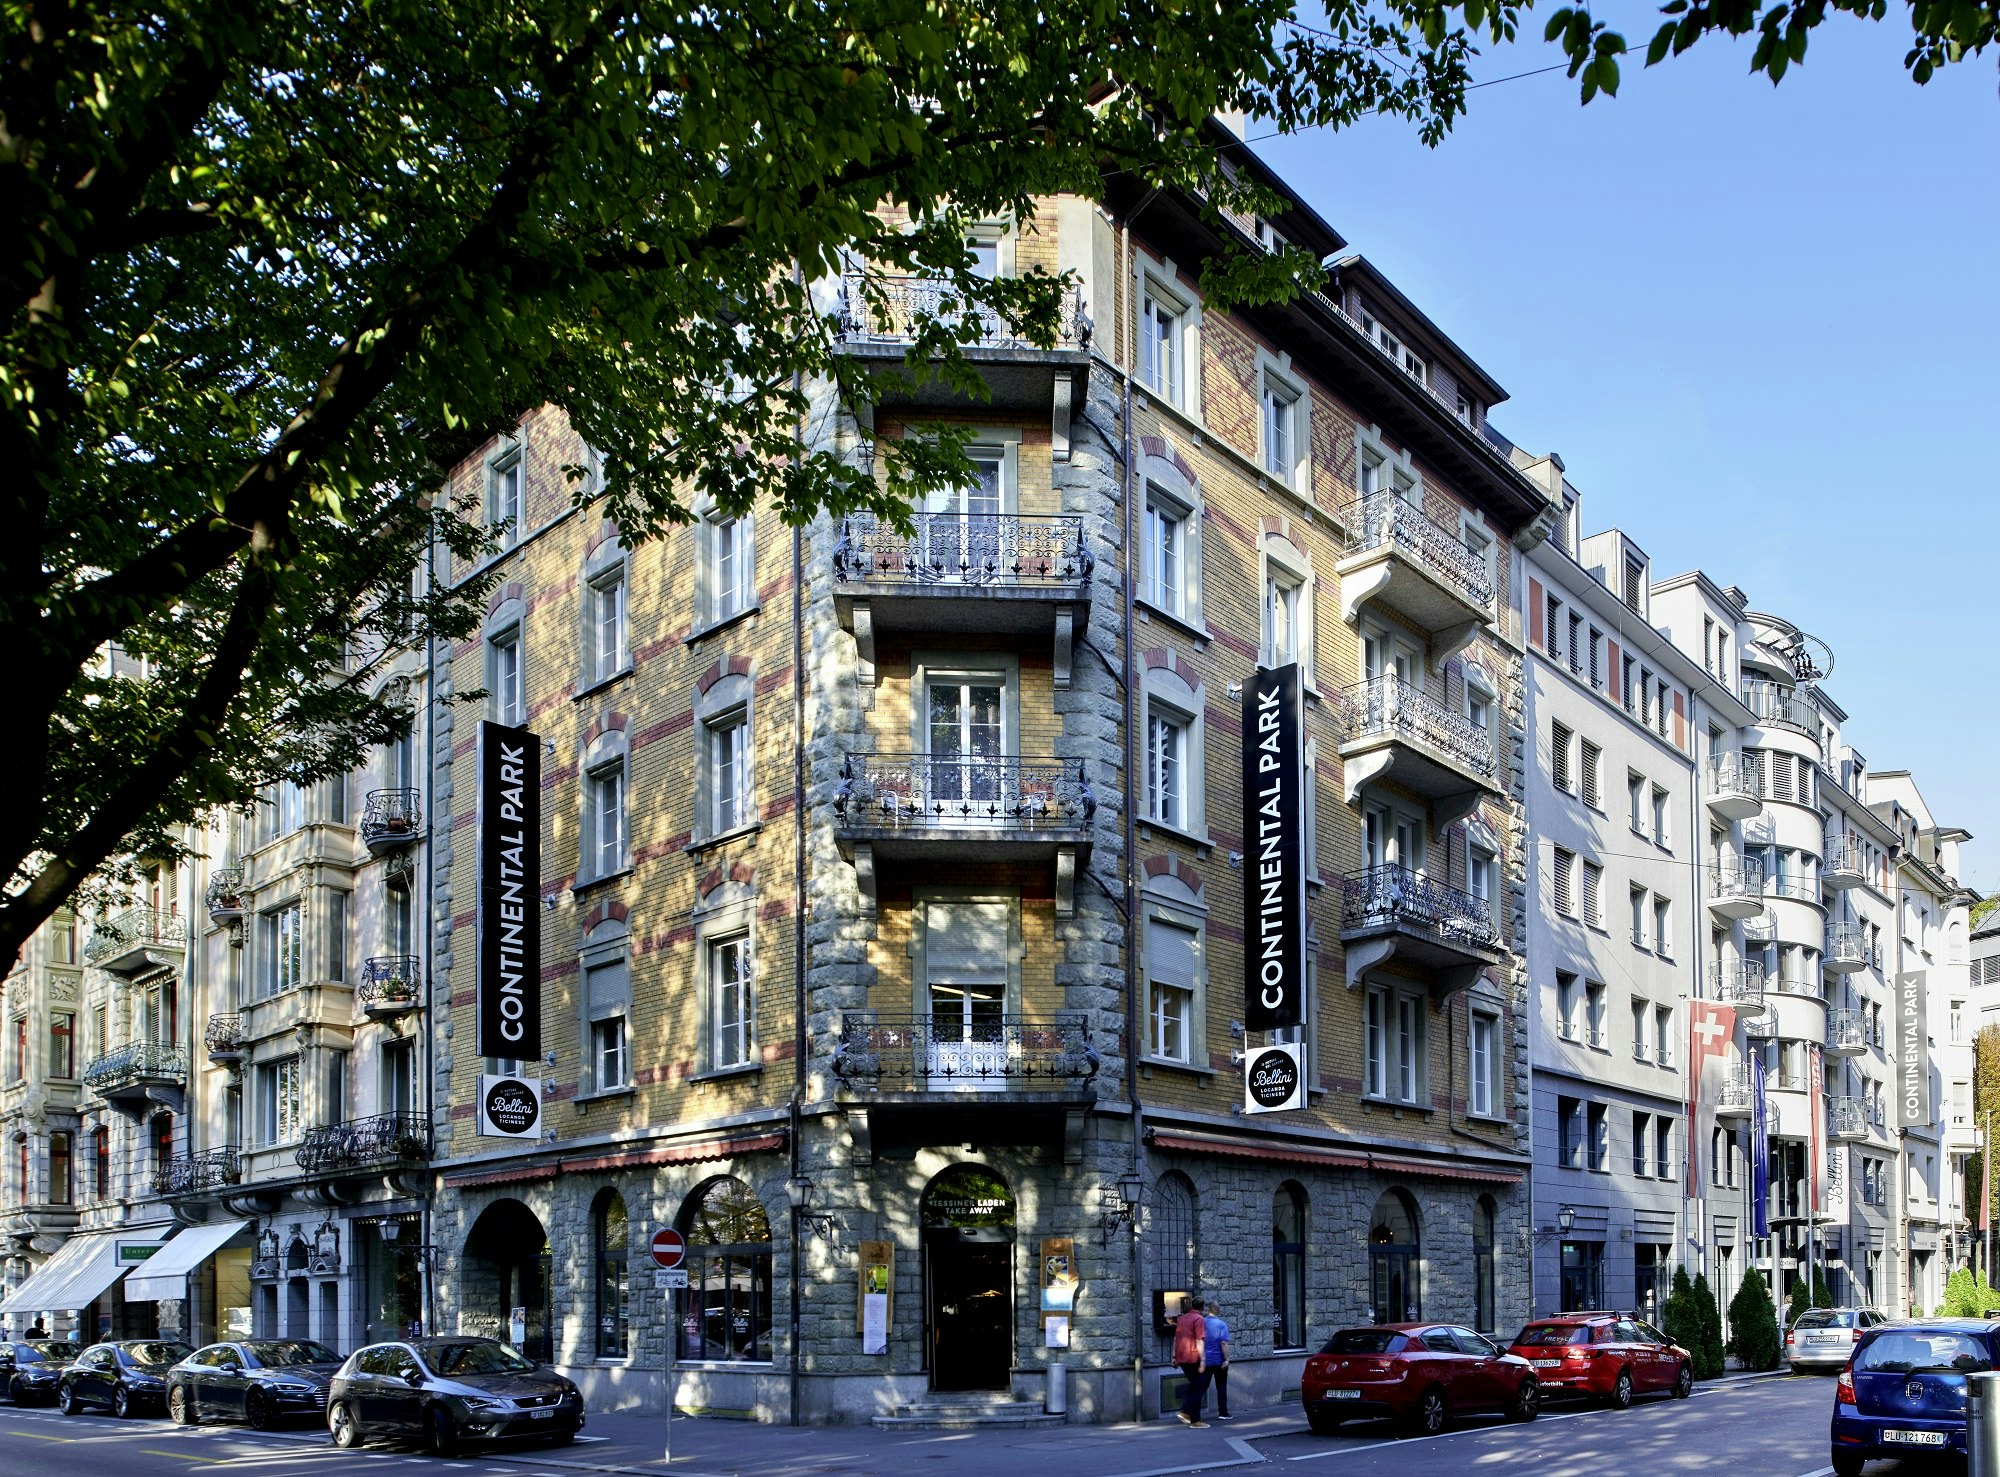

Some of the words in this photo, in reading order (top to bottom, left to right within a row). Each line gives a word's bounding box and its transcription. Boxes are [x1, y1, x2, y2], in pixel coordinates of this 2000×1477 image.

[1258, 685, 1281, 774] PARK
[501, 742, 524, 823] PARK
[1259, 778, 1283, 1009] CONTINENTAL
[501, 831, 524, 1042] CONTINENTAL
[1904, 978, 1917, 1017] PARK
[1253, 1068, 1293, 1087] Bellini
[1905, 1019, 1919, 1119] CONTINENTAL
[491, 1097, 533, 1113] Bellini
[977, 1199, 1006, 1207] LADEN
[1827, 1151, 1843, 1205] Bellini
